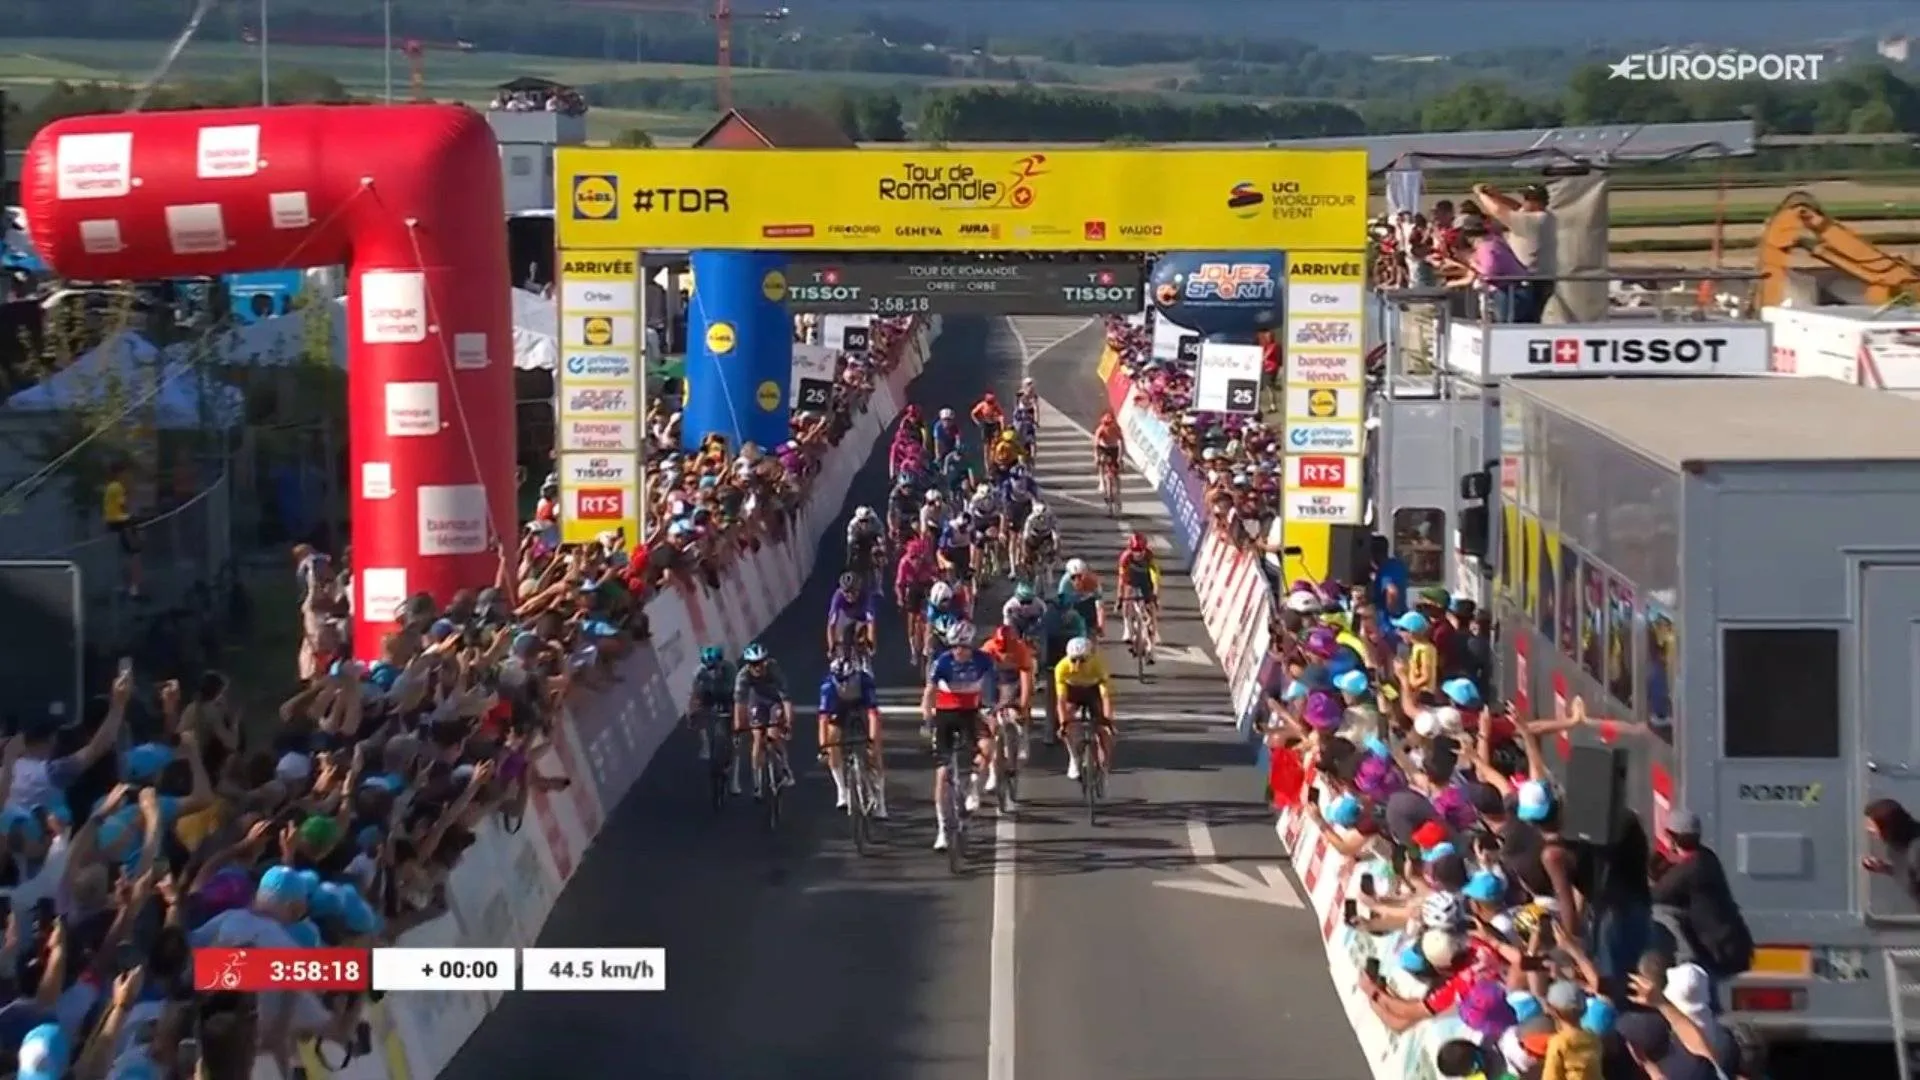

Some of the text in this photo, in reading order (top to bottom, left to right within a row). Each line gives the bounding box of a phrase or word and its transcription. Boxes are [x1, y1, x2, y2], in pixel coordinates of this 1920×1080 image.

[903, 163, 974, 181] Tour de
[879, 178, 997, 201] Romandie
[1272, 182, 1299, 193] UCI
[633, 187, 729, 213] #TDR
[1272, 194, 1356, 206] WORLDTOUR
[1272, 207, 1313, 219] EVENT
[895, 226, 943, 236] GENEVA
[958, 223, 990, 233] JURA
[563, 259, 633, 274] ARRIVÉE
[1189, 264, 1271, 280] JOUEZ
[1290, 262, 1361, 276] ARRIVÉE
[788, 286, 861, 300] TISSOT
[1062, 286, 1136, 301] TISSOT
[869, 297, 929, 312] 3:58:18
[1584, 339, 1727, 363] TISSOT
[806, 388, 825, 403] 25
[1233, 389, 1253, 404] 25
[575, 467, 624, 478] TISSOT
[1303, 464, 1342, 481] RTS
[581, 496, 620, 513] RTS
[1297, 505, 1347, 516] TISSOT
